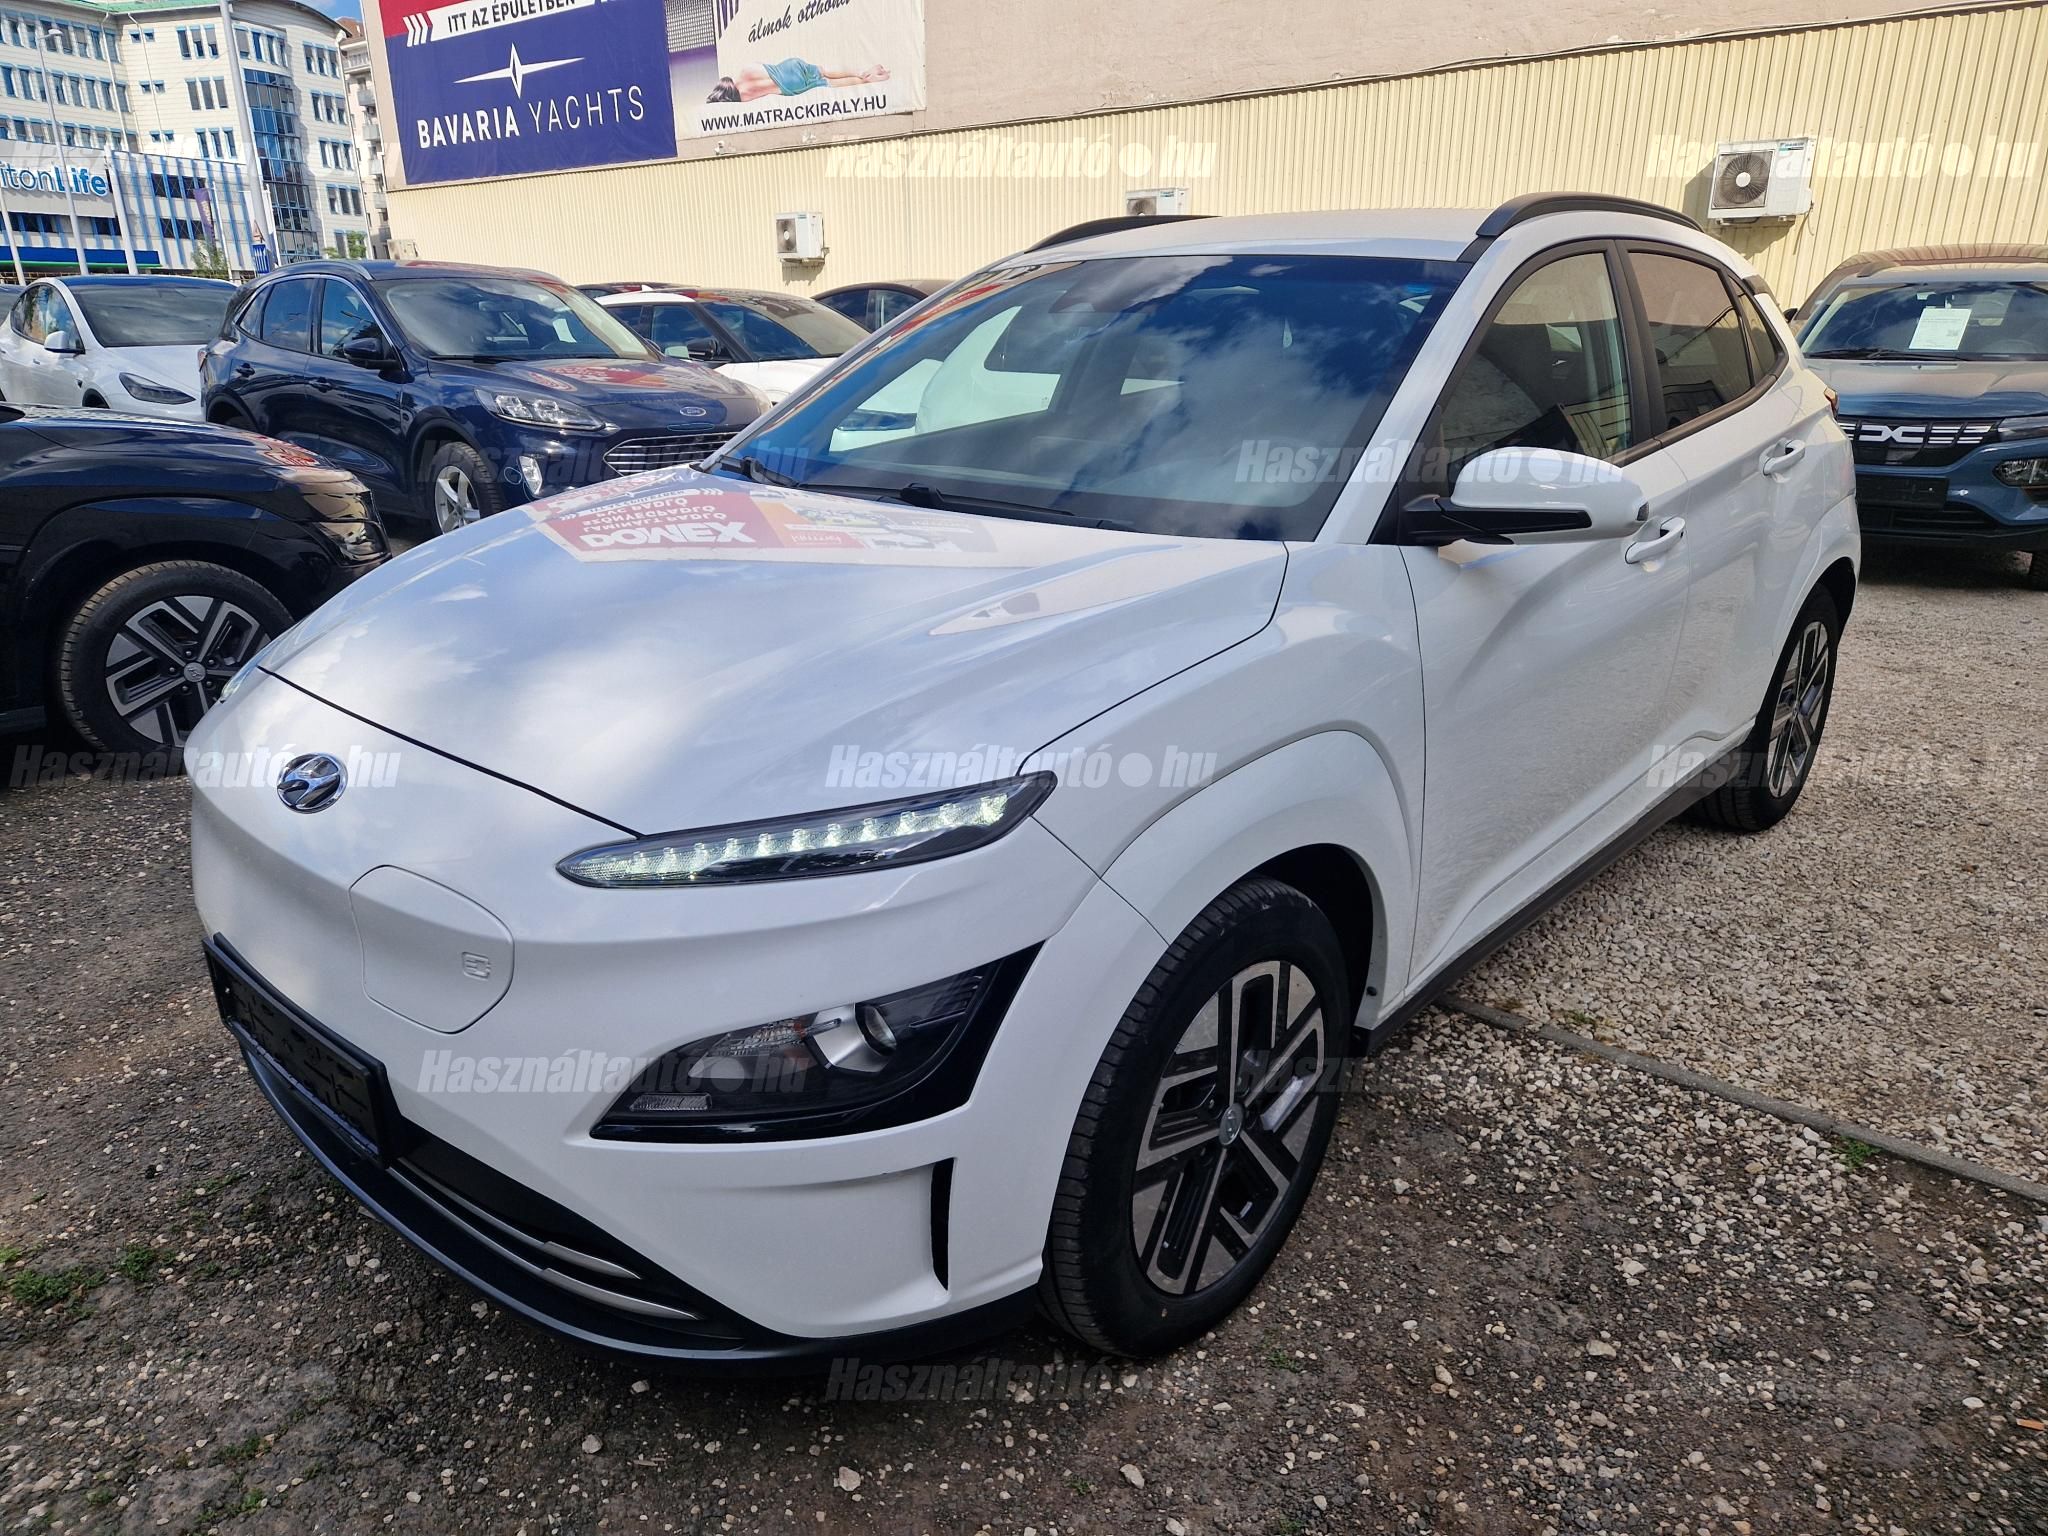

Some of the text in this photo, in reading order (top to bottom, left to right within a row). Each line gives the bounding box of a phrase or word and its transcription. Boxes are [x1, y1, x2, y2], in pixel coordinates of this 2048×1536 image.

[447, 12, 467, 33] ITT
[472, 8, 489, 28] AZ
[748, 5, 793, 43] álmok
[417, 85, 645, 149] BAVARIA YACHTS
[701, 95, 887, 132] WWW.MATRACKIRALY.HU
